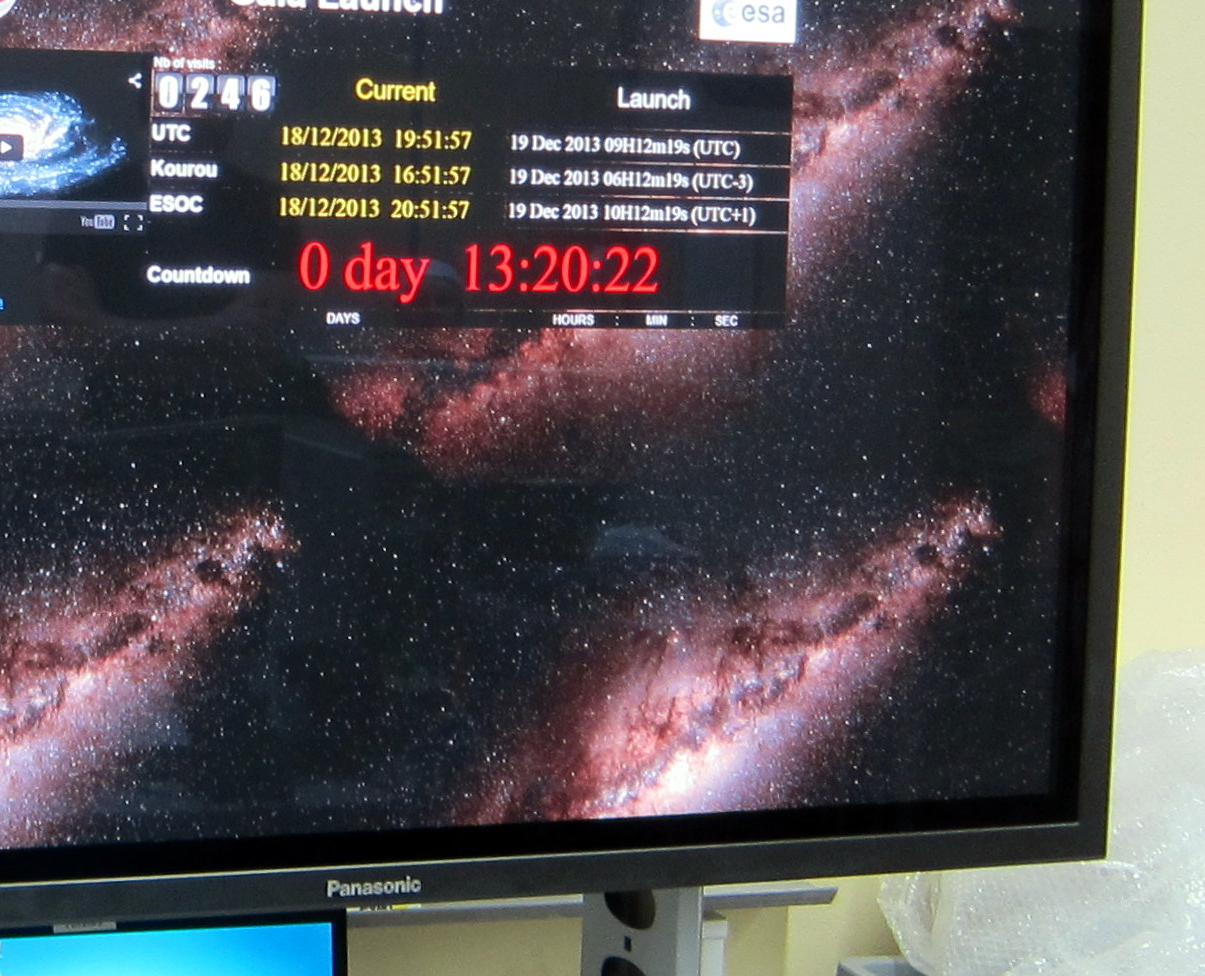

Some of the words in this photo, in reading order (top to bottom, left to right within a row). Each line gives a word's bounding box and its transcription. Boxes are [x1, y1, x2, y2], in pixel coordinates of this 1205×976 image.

[741, 3, 786, 24] esa
[153, 57, 171, 68] Nb
[174, 57, 186, 69] of
[187, 57, 216, 70] visits
[355, 77, 437, 103] Current
[617, 86, 691, 111] Launch
[151, 124, 191, 142] UTC
[281, 125, 383, 148] 18/12/2013
[395, 129, 472, 150] 19:51:57
[509, 133, 529, 152] 19
[532, 135, 561, 153] Dec
[564, 136, 600, 154] 2013
[693, 139, 741, 160] (UTC)
[150, 160, 218, 178] Kourou
[279, 161, 381, 184] 18/12/2013
[393, 164, 471, 185] 16:51:57
[509, 168, 529, 186] 19
[531, 169, 560, 187] Dec
[563, 169, 599, 188] 2013
[692, 172, 754, 194] (UTC-3)
[149, 196, 204, 214] ESOC
[278, 196, 380, 218] 18/12/2013
[390, 198, 470, 220] 20:51:57
[507, 202, 527, 220] 19
[530, 203, 559, 221] Dec
[562, 203, 598, 222] 2013
[691, 205, 756, 227] (UTC+1)
[146, 266, 251, 284] Countdown
[299, 242, 329, 291] 0
[343, 244, 430, 303] day
[465, 244, 659, 295] 13:20:22
[326, 312, 360, 325] DAYS
[552, 314, 594, 326] HOURS
[646, 315, 668, 327] MIN
[714, 315, 738, 327] SEC
[326, 875, 422, 898] Panasonic
